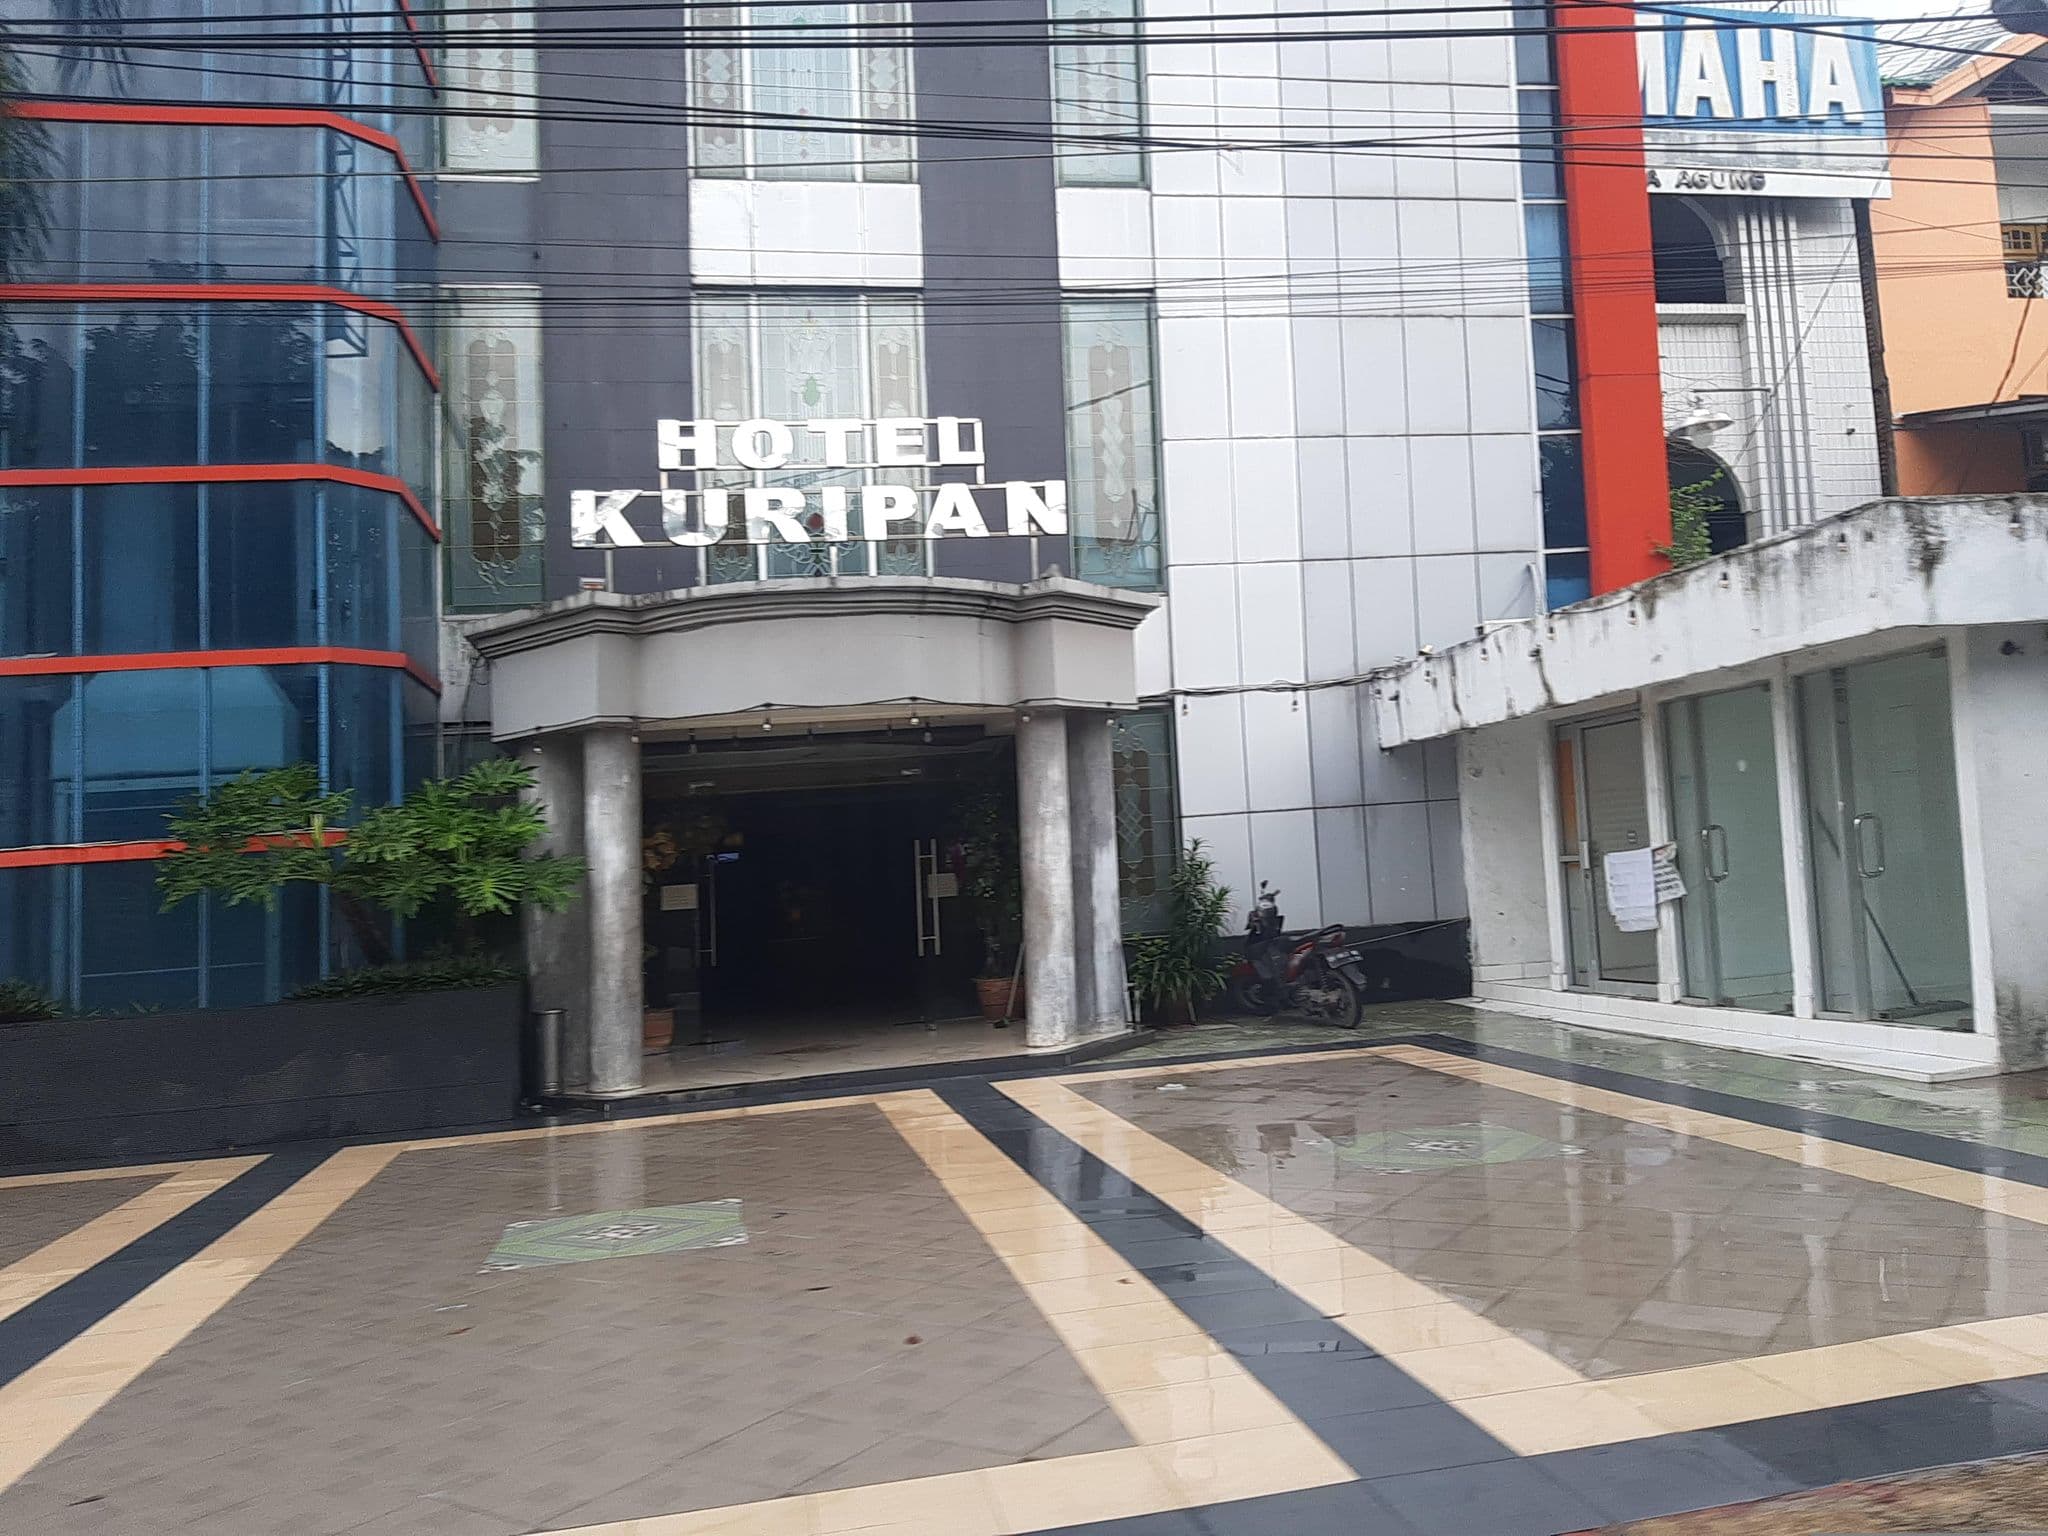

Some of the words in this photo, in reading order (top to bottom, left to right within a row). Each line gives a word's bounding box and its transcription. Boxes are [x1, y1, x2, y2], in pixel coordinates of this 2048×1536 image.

[1675, 170, 1767, 191] AGUNG
[657, 416, 985, 471] HOTEL
[570, 480, 1068, 548] KURIPAN
